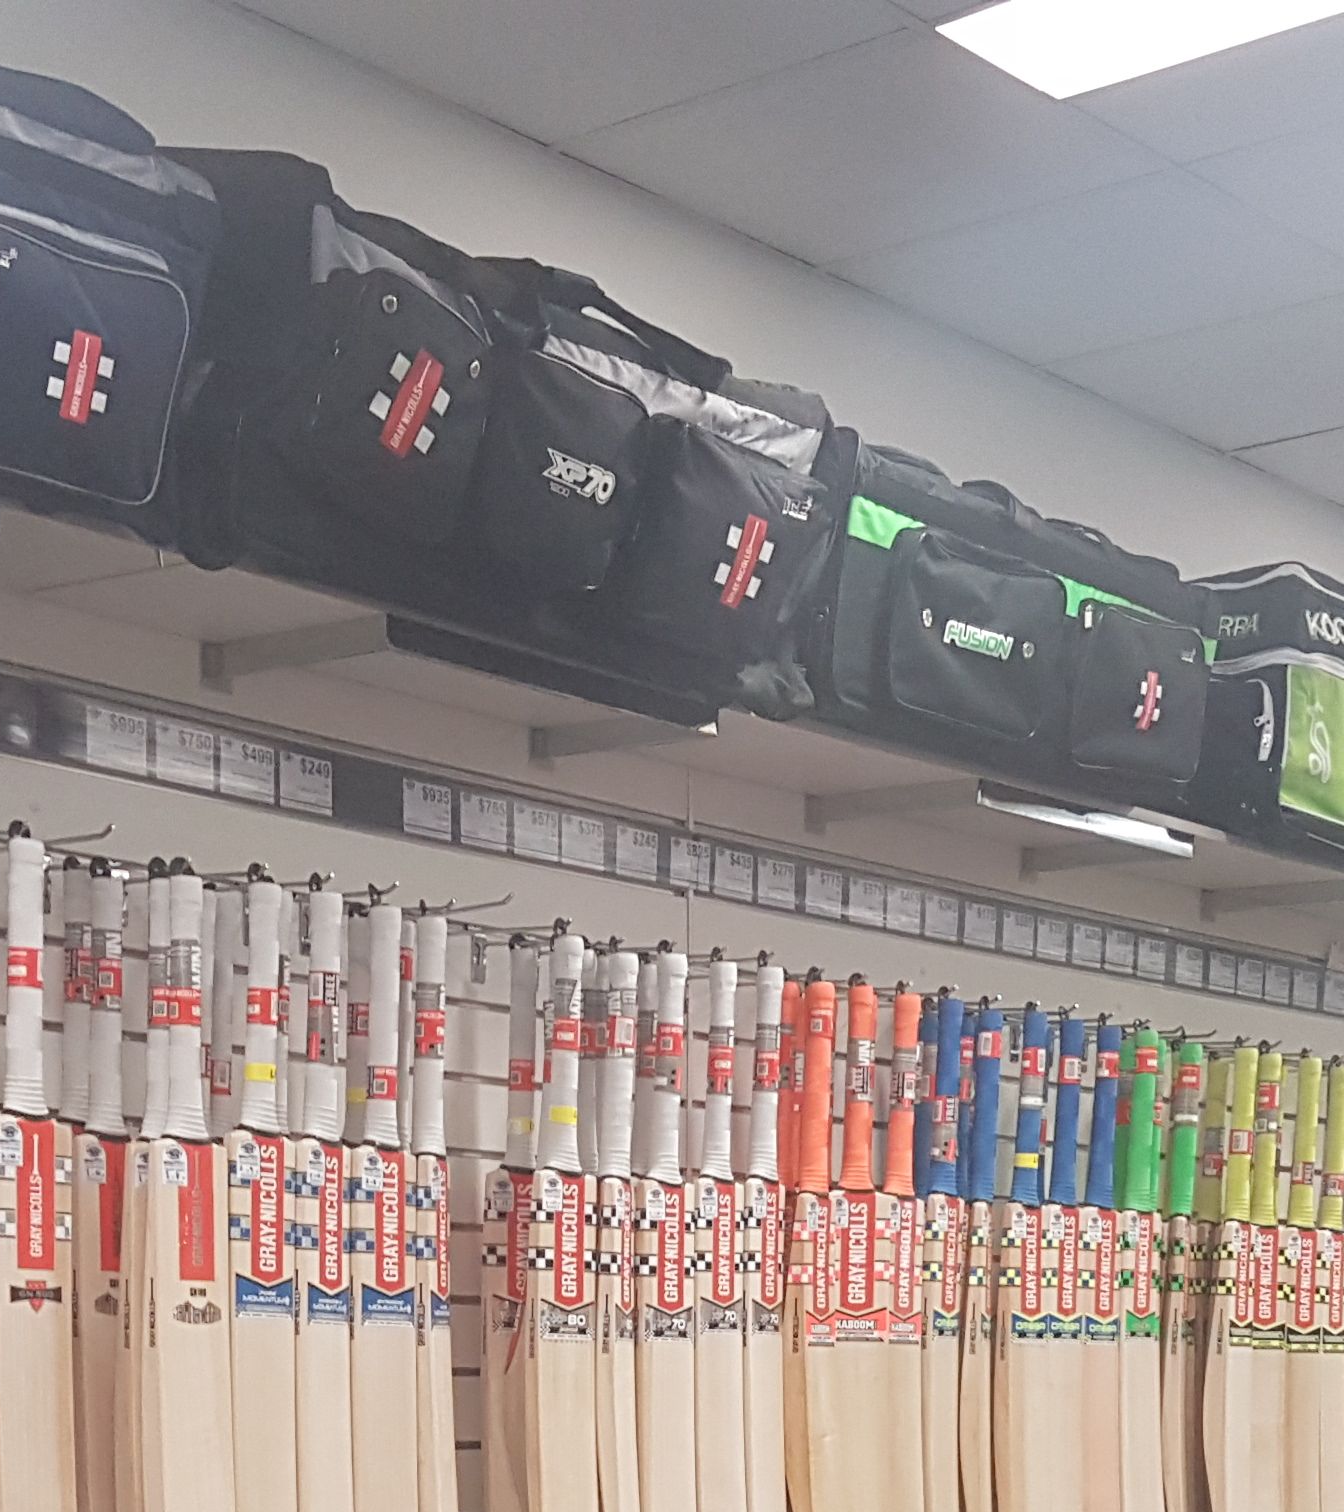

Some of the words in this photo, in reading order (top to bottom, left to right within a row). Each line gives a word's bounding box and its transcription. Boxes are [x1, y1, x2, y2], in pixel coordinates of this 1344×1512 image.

[943, 619, 1014, 661] FUSION
[28, 1174, 43, 1258] GRAY-NICOLLS
[258, 1143, 278, 1273] GRAY-NICOLLS
[324, 1155, 339, 1282] GRAY-NICOLLS
[382, 1160, 400, 1283] GRAY-NICOLLS
[560, 1183, 579, 1298] GRAY-NICOLLS
[663, 1193, 680, 1303] GRAY-NICOLLS
[717, 1193, 732, 1297] GRAY-NICOLLS
[765, 1192, 777, 1298] GRAY-NICOLLS
[847, 1202, 869, 1305] GRAY-NICOLLS
[1025, 1214, 1038, 1310] GRAY-NICOLLS
[1062, 1215, 1076, 1309] GRAY-NICOLLS
[1099, 1217, 1113, 1311] GRAY-NICOLLS
[1258, 1232, 1274, 1320] GRAY-NICOLLS
[1299, 1238, 1314, 1322] GRAY-NICOLLS
